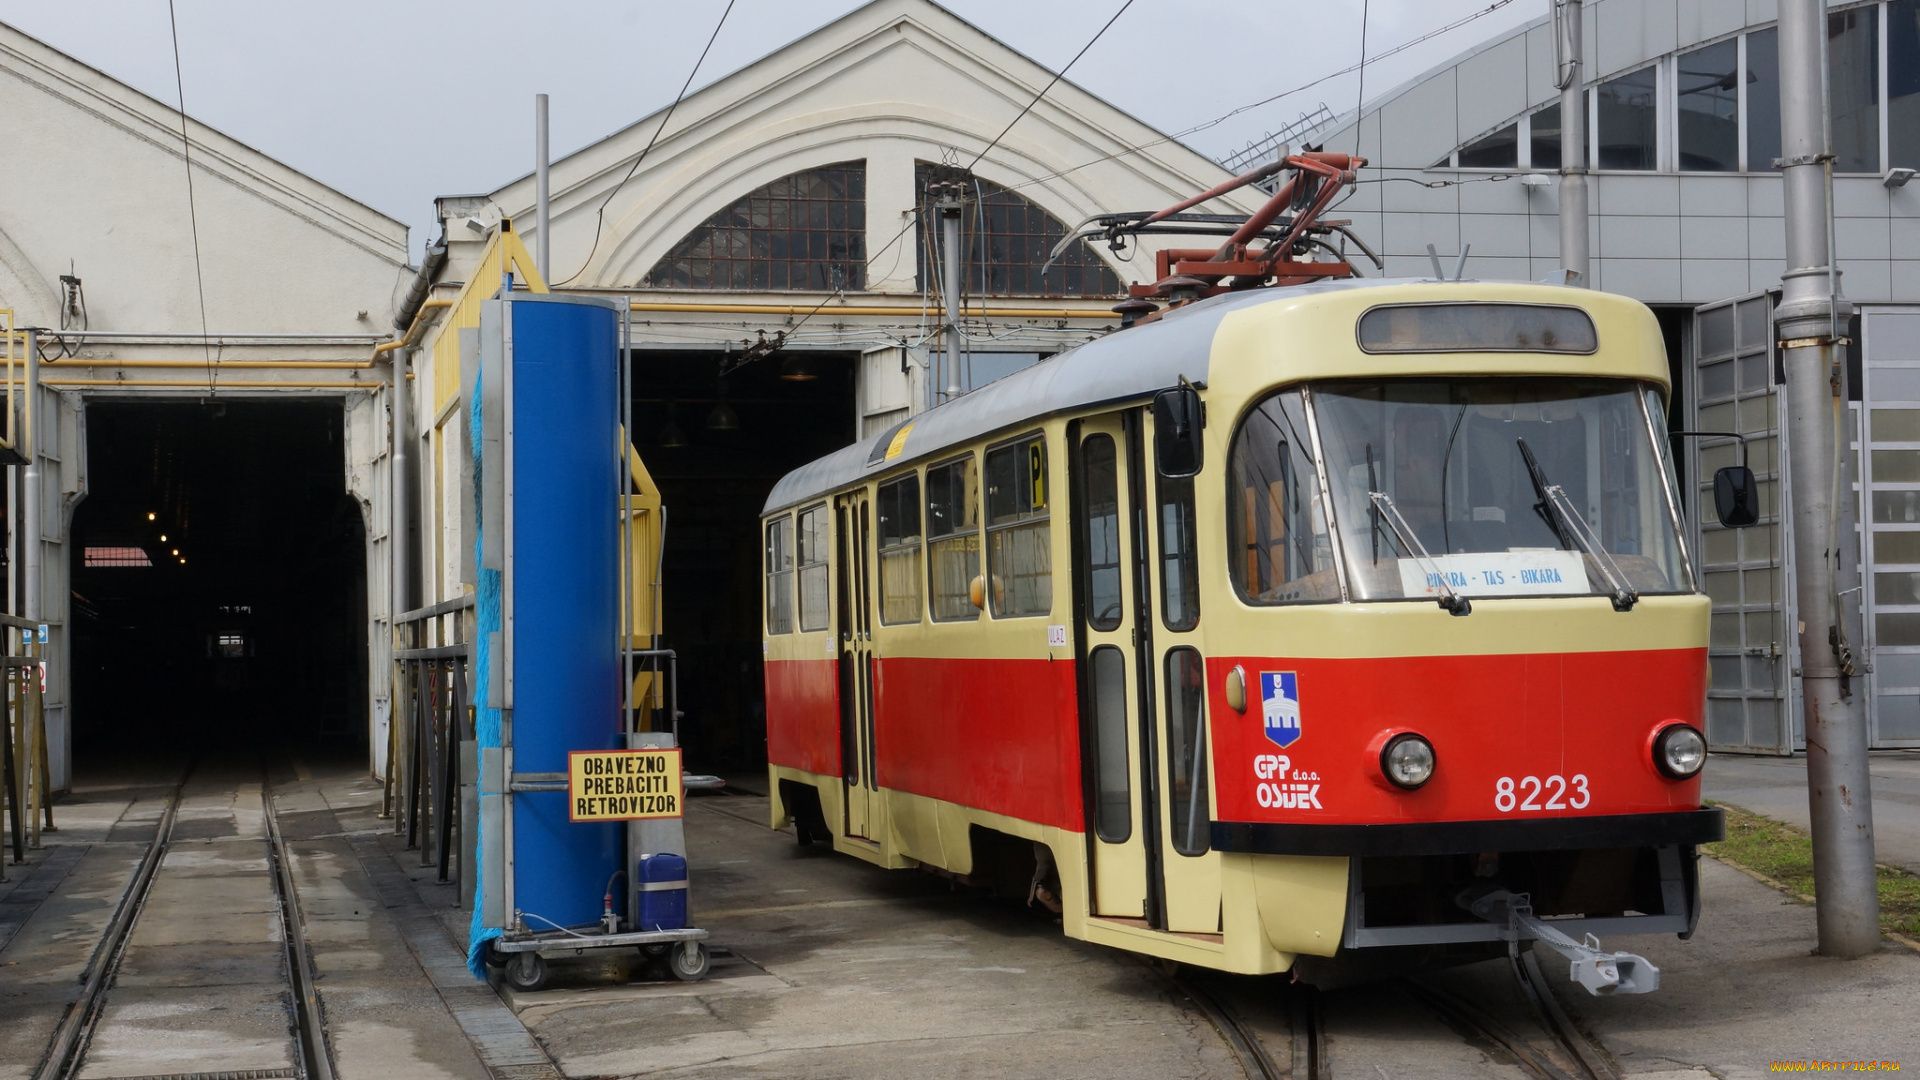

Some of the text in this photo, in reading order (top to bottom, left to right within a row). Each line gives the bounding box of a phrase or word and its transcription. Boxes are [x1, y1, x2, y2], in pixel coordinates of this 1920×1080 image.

[1031, 446, 1041, 503] P
[1482, 570, 1505, 586] TAS
[1520, 568, 1562, 584] BIKARA
[583, 755, 666, 775] OBAVEZNO
[1253, 754, 1321, 781] GPP d.o.o.
[584, 775, 668, 796] PREBACITI
[1256, 782, 1323, 809] OSIJEK
[1494, 773, 1591, 812] 8223
[577, 794, 676, 815] RETROVIZOR
